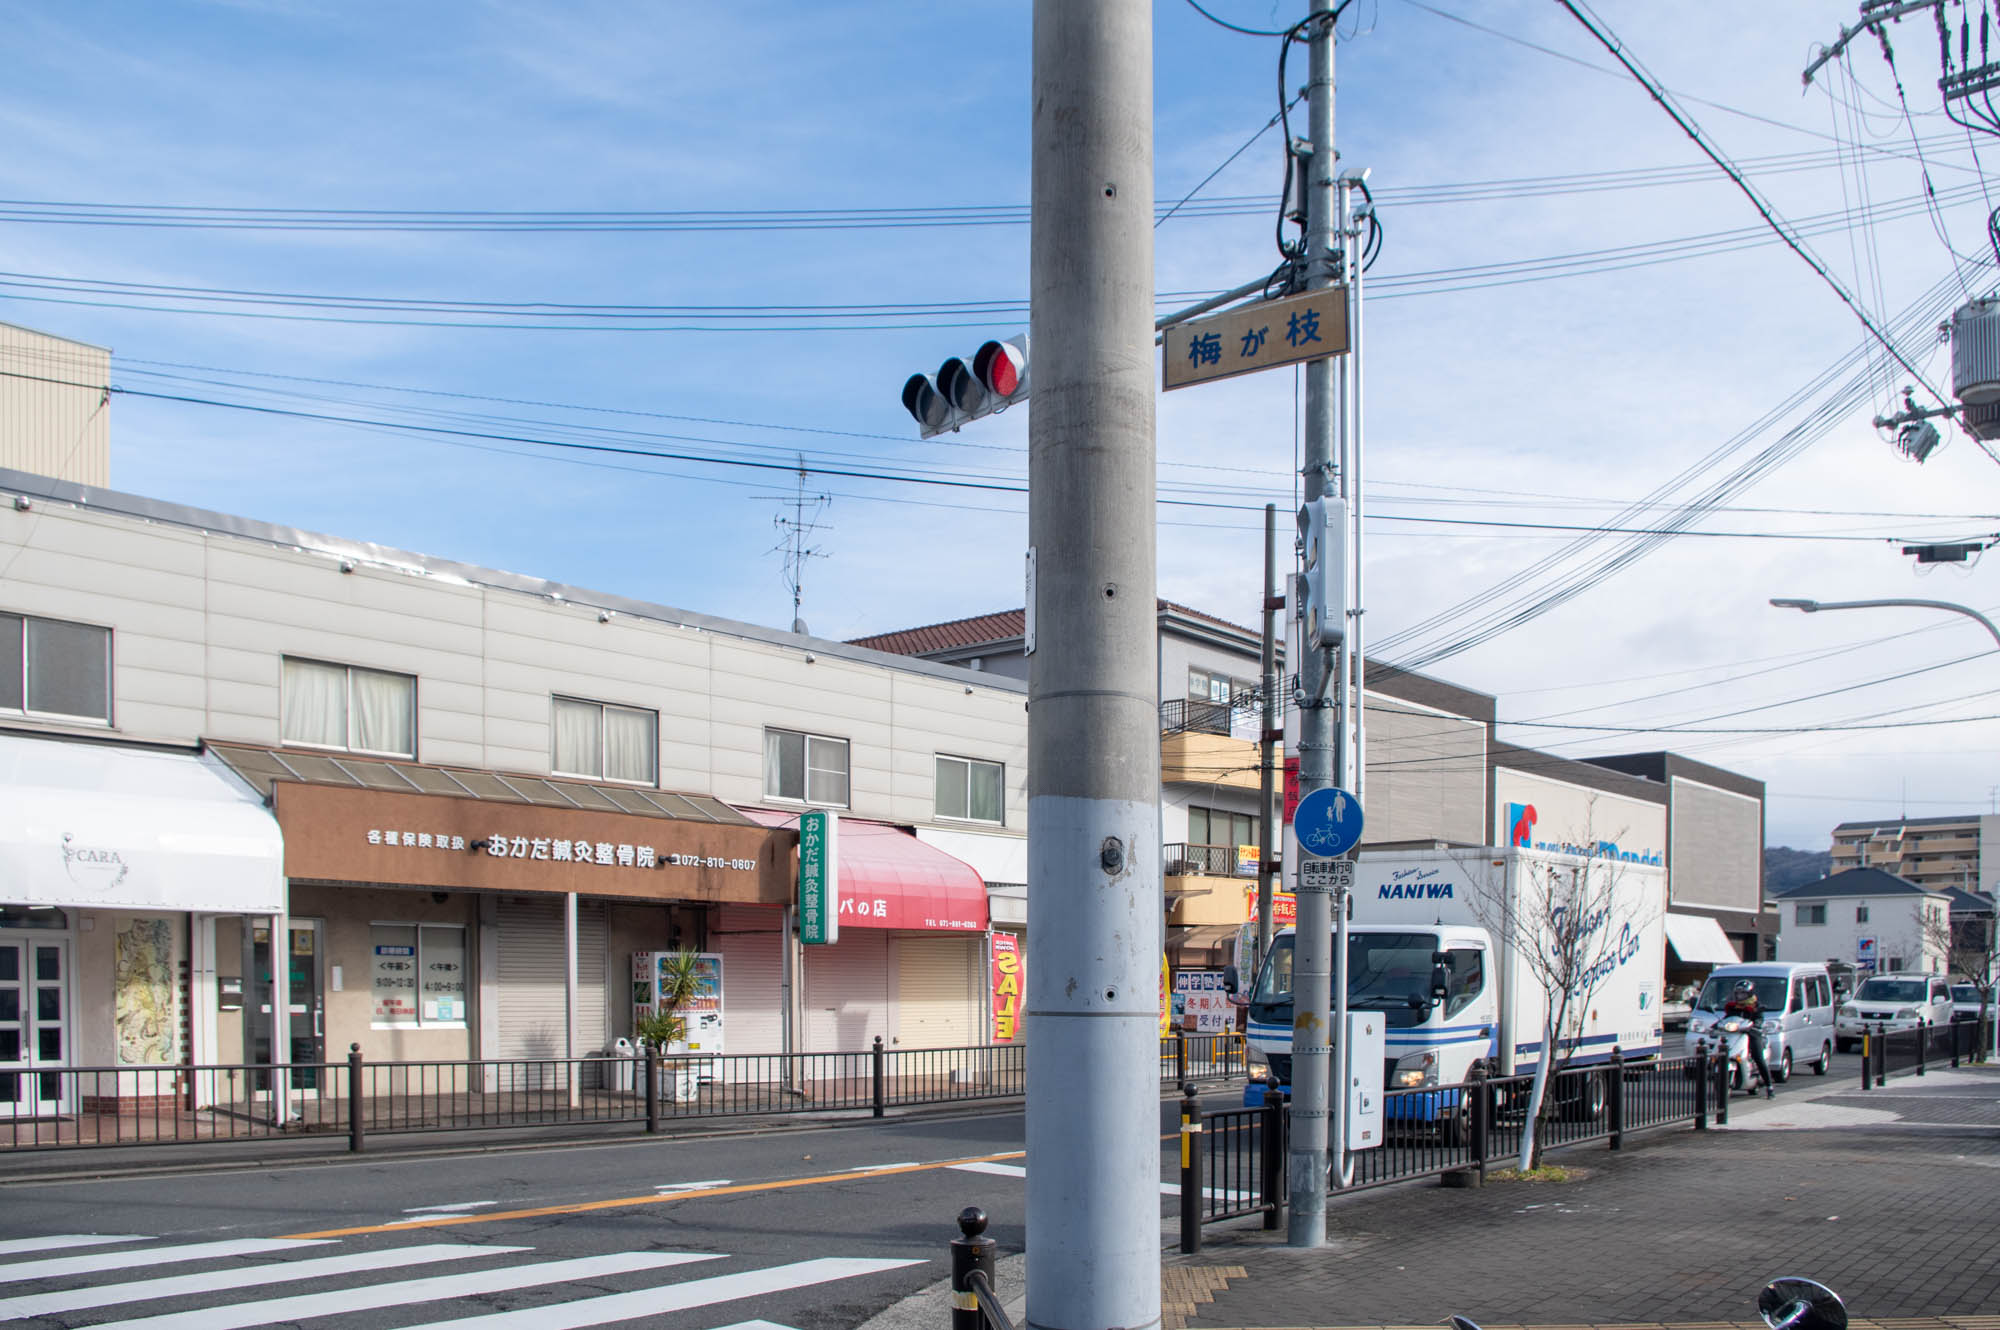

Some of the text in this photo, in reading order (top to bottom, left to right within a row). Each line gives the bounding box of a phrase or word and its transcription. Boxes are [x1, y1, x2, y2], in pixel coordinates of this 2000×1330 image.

[1188, 309, 1322, 369] 梅が枝
[367, 829, 465, 850] 各種保険取扱
[487, 833, 655, 868] おかだ鍼灸整骨院
[804, 816, 820, 940] おかだ鍼灸整骨院
[1303, 862, 1353, 874] 自転車通行可
[1306, 875, 1350, 885] ここから
[1378, 883, 1454, 899] NANIWA
